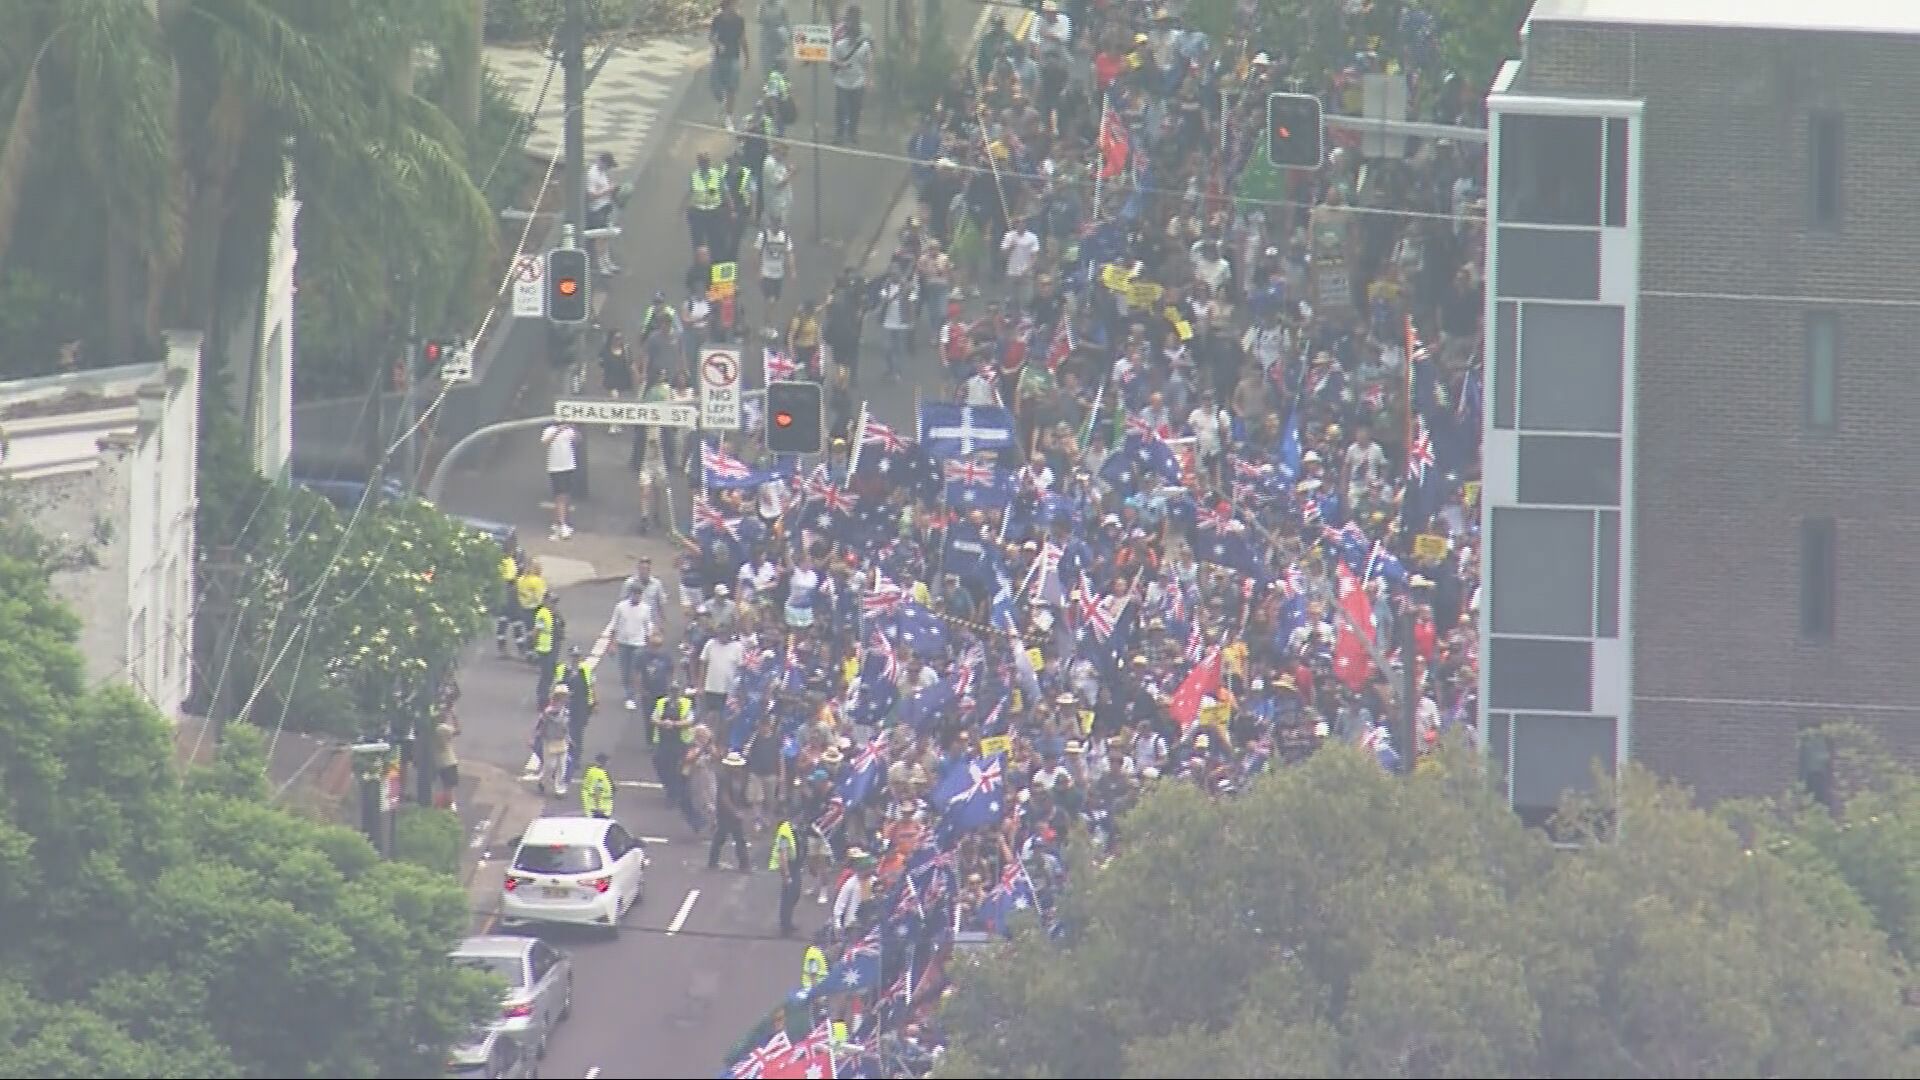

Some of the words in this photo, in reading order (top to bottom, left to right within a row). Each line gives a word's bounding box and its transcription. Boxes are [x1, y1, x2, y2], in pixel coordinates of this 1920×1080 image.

[709, 389, 731, 401] NO
[560, 405, 661, 421] CHALMERS
[671, 409, 689, 422] ST
[707, 404, 734, 413] LEFT
[706, 416, 735, 425] TURN
